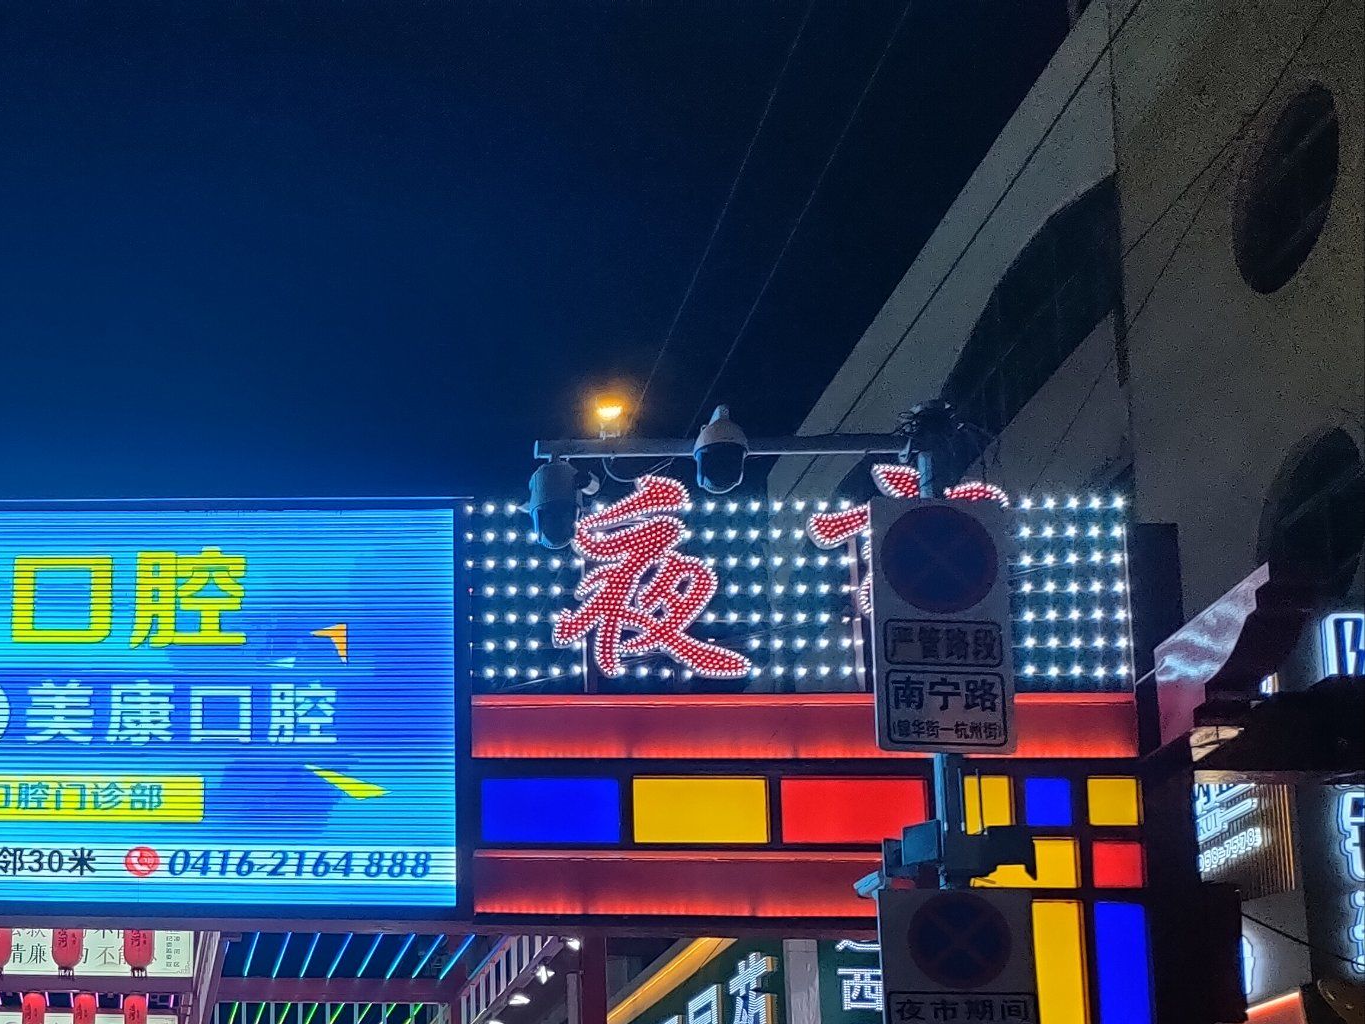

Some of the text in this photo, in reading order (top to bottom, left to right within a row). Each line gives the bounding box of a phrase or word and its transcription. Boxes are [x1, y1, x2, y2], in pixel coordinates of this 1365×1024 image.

[891, 675, 999, 712] 南宁路
[896, 999, 1029, 1021] 夜市期间
